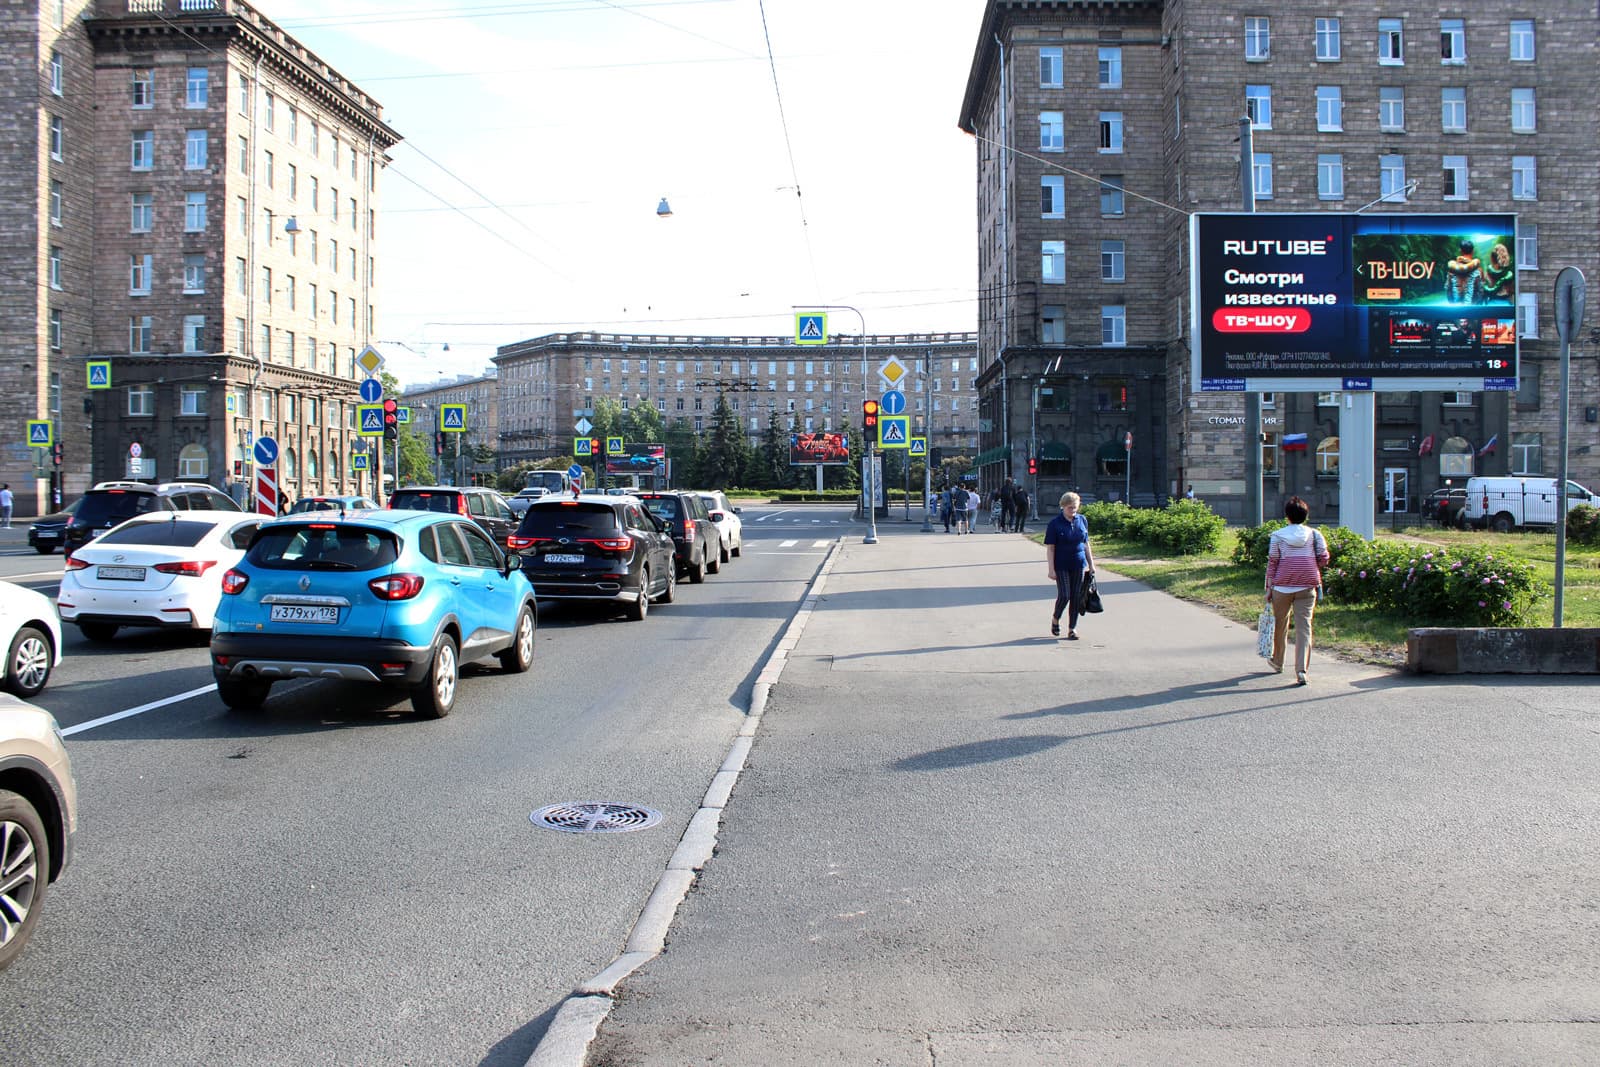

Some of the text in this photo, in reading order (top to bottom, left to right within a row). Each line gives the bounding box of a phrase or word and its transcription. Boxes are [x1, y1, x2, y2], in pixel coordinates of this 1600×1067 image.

[1223, 240, 1326, 255] RUTUBE
[1367, 260, 1435, 280] ТВ-ШОУ
[1224, 269, 1304, 288] Смотри
[1224, 293, 1337, 305] известные
[1224, 315, 1297, 330] тв-шоу
[866, 416, 876, 425] 04
[319, 607, 336, 617] 178
